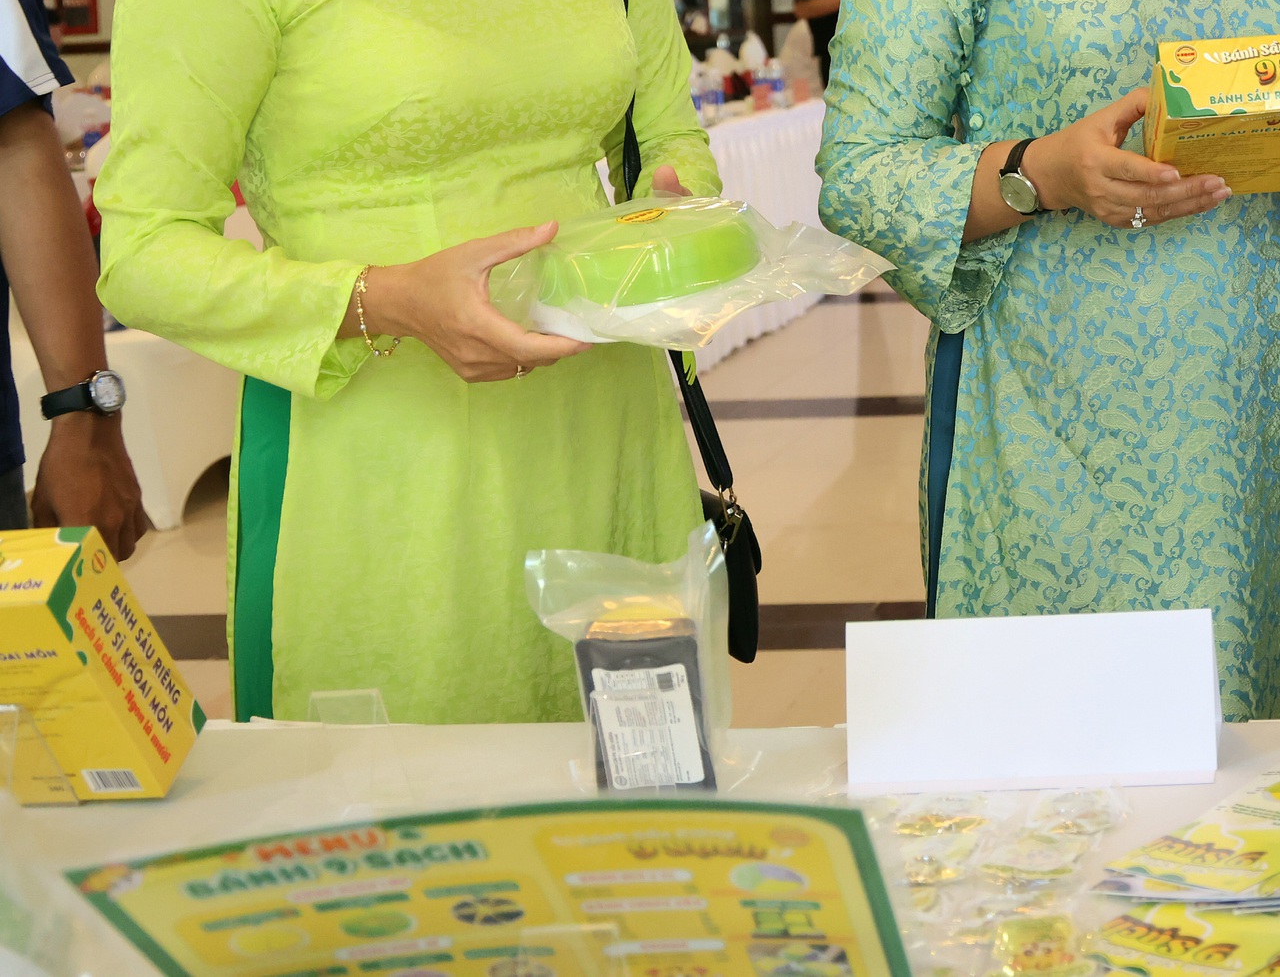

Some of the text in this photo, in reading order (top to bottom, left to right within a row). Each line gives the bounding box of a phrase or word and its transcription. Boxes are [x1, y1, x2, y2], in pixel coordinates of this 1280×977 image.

[1220, 47, 1259, 64] Bánh
[1255, 59, 1277, 85] 9
[1209, 93, 1243, 105] BÁNH
[24, 648, 58, 660] MÔN
[110, 584, 138, 631] BÁNH
[152, 658, 182, 706] RIÊNG
[91, 598, 117, 635] PHÚ
[120, 647, 153, 700] KHOAI
[149, 694, 174, 734] MÔN
[124, 689, 146, 724] Ngon
[255, 829, 381, 863] MENU
[185, 864, 312, 898] BÁNH
